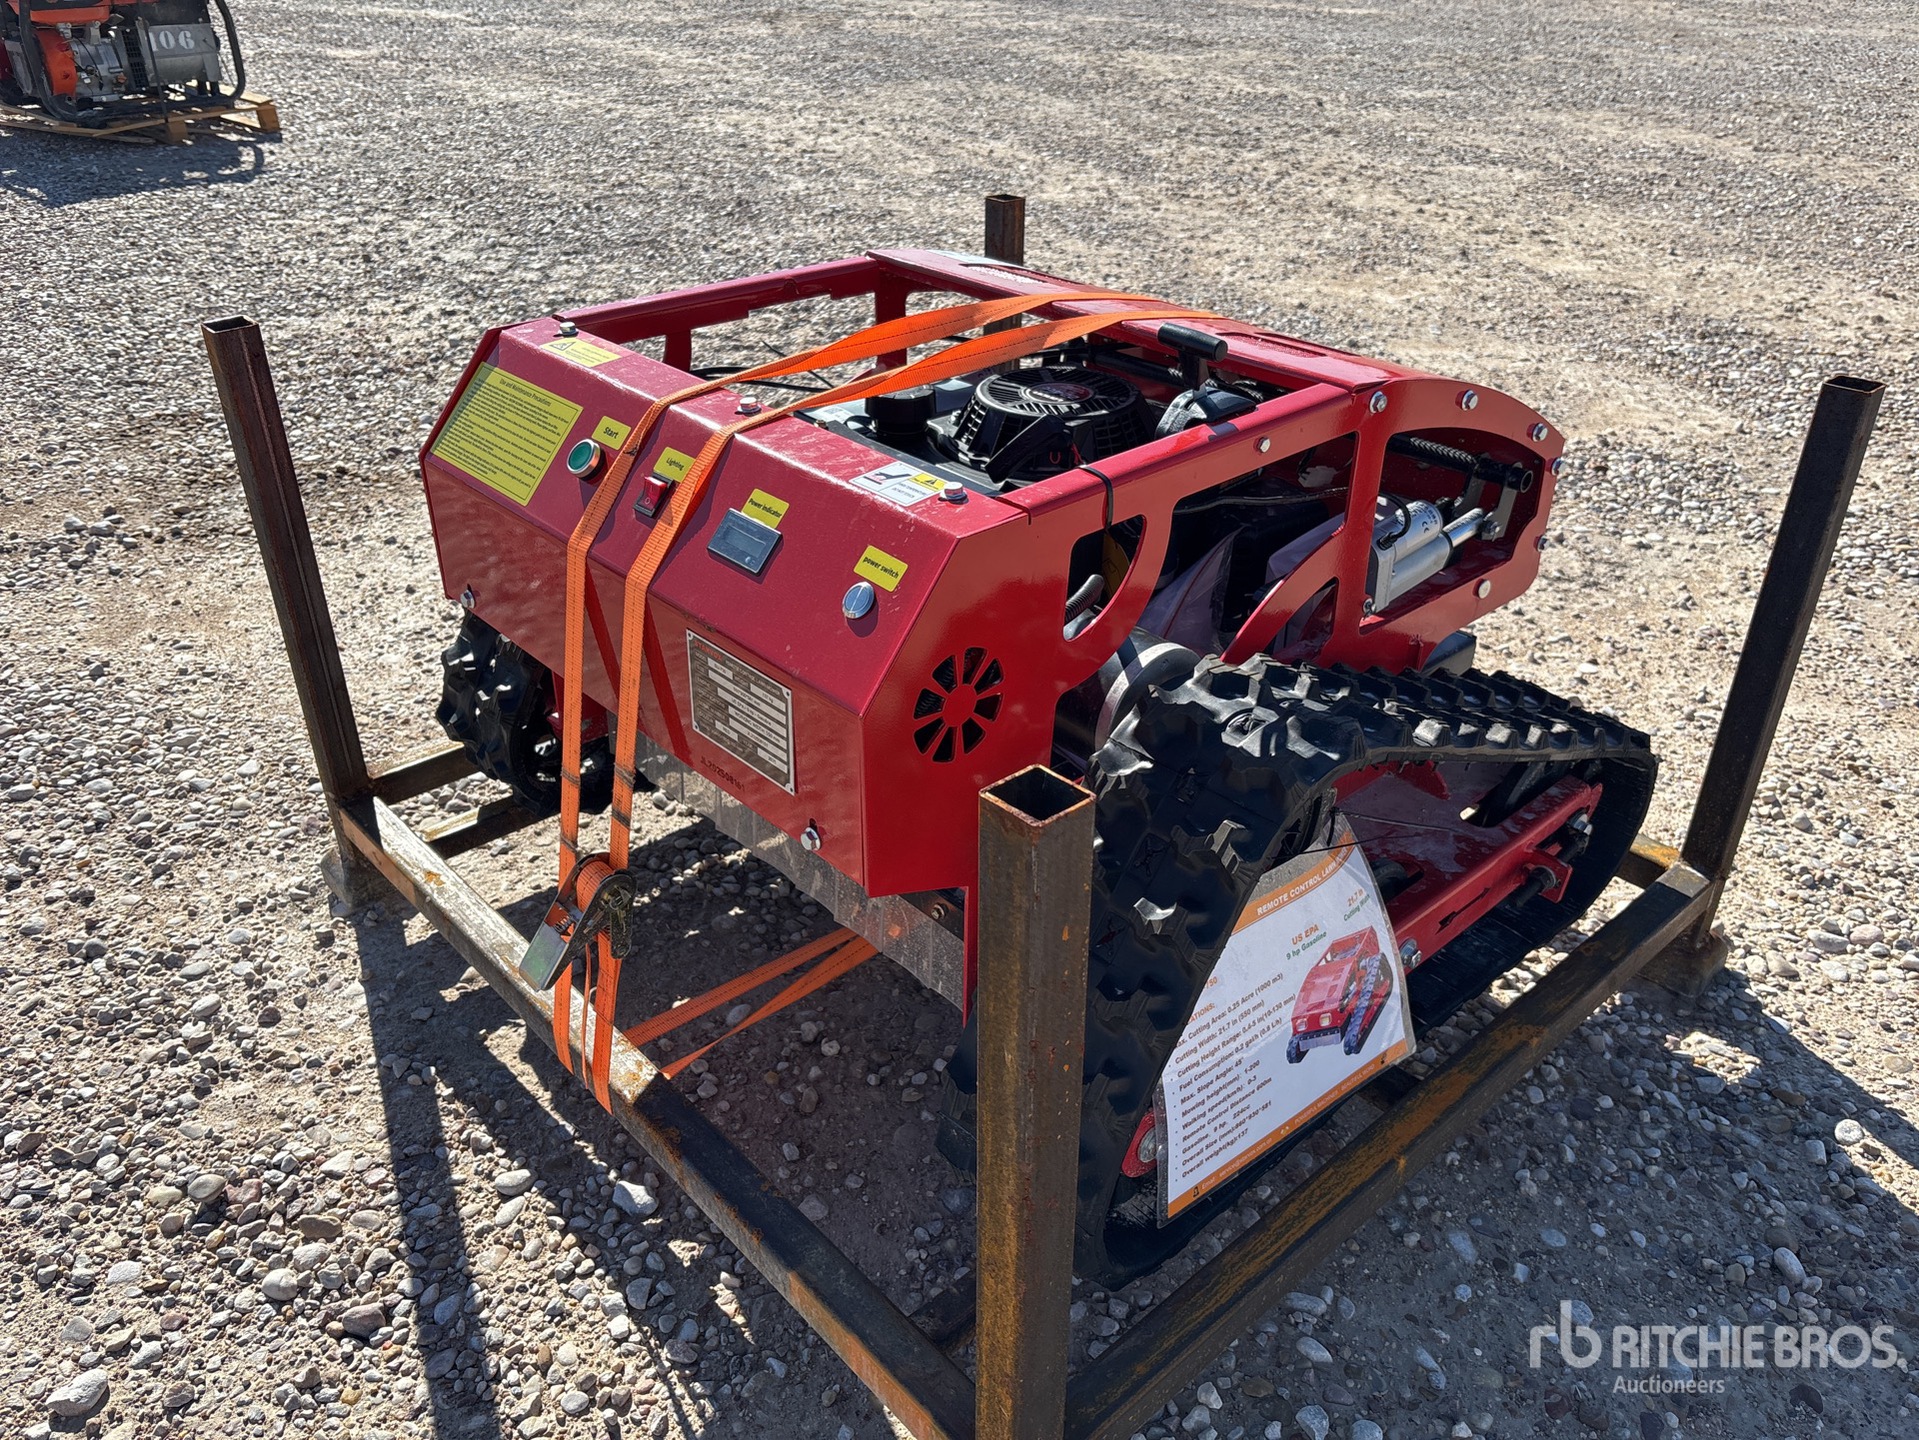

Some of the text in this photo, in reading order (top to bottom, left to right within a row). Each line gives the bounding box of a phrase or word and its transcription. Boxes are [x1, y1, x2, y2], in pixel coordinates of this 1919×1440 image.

[603, 426, 619, 440] Start
[665, 456, 685, 472] Lighting
[748, 498, 763, 510] Power
[863, 556, 899, 579] power switch
[1257, 893, 1289, 915] REMOTE
[1289, 873, 1321, 899] CONTROL
[1291, 924, 1319, 946] US EPA
[1292, 948, 1300, 959] hp
[1301, 931, 1327, 949] Gasoline
[1188, 1021, 1210, 1040] Cutting
[1211, 1011, 1226, 1024] Area:
[1227, 1002, 1239, 1013] 0.25
[1240, 992, 1254, 1004] Acre
[1255, 981, 1270, 995] (1000
[1175, 999, 1264, 1065] Cutting Width: 21.7 in (550 mm)
[1177, 1059, 1199, 1078] Cutting
[1200, 1044, 1220, 1063] Height
[1221, 1029, 1241, 1048] Range:
[1283, 993, 1295, 1006] mm)
[1179, 1078, 1192, 1091] Fuel
[1193, 1050, 1233, 1082] Consumption:
[1235, 1043, 1243, 1053] 0.2
[1180, 1090, 1195, 1104] Max.
[1196, 1078, 1213, 1094] Slope
[1214, 1064, 1233, 1082] Angle:
[1181, 1098, 1205, 1118] Mowing
[1182, 1123, 1205, 1142] Remote
[1206, 1106, 1229, 1125] Control
[1229, 1089, 1255, 1109] Distance
[1182, 1110, 1206, 1130] Walking
[1181, 1147, 1203, 1166] Overall
[1204, 1138, 1217, 1150] Size
[1181, 1160, 1203, 1178] Overall
